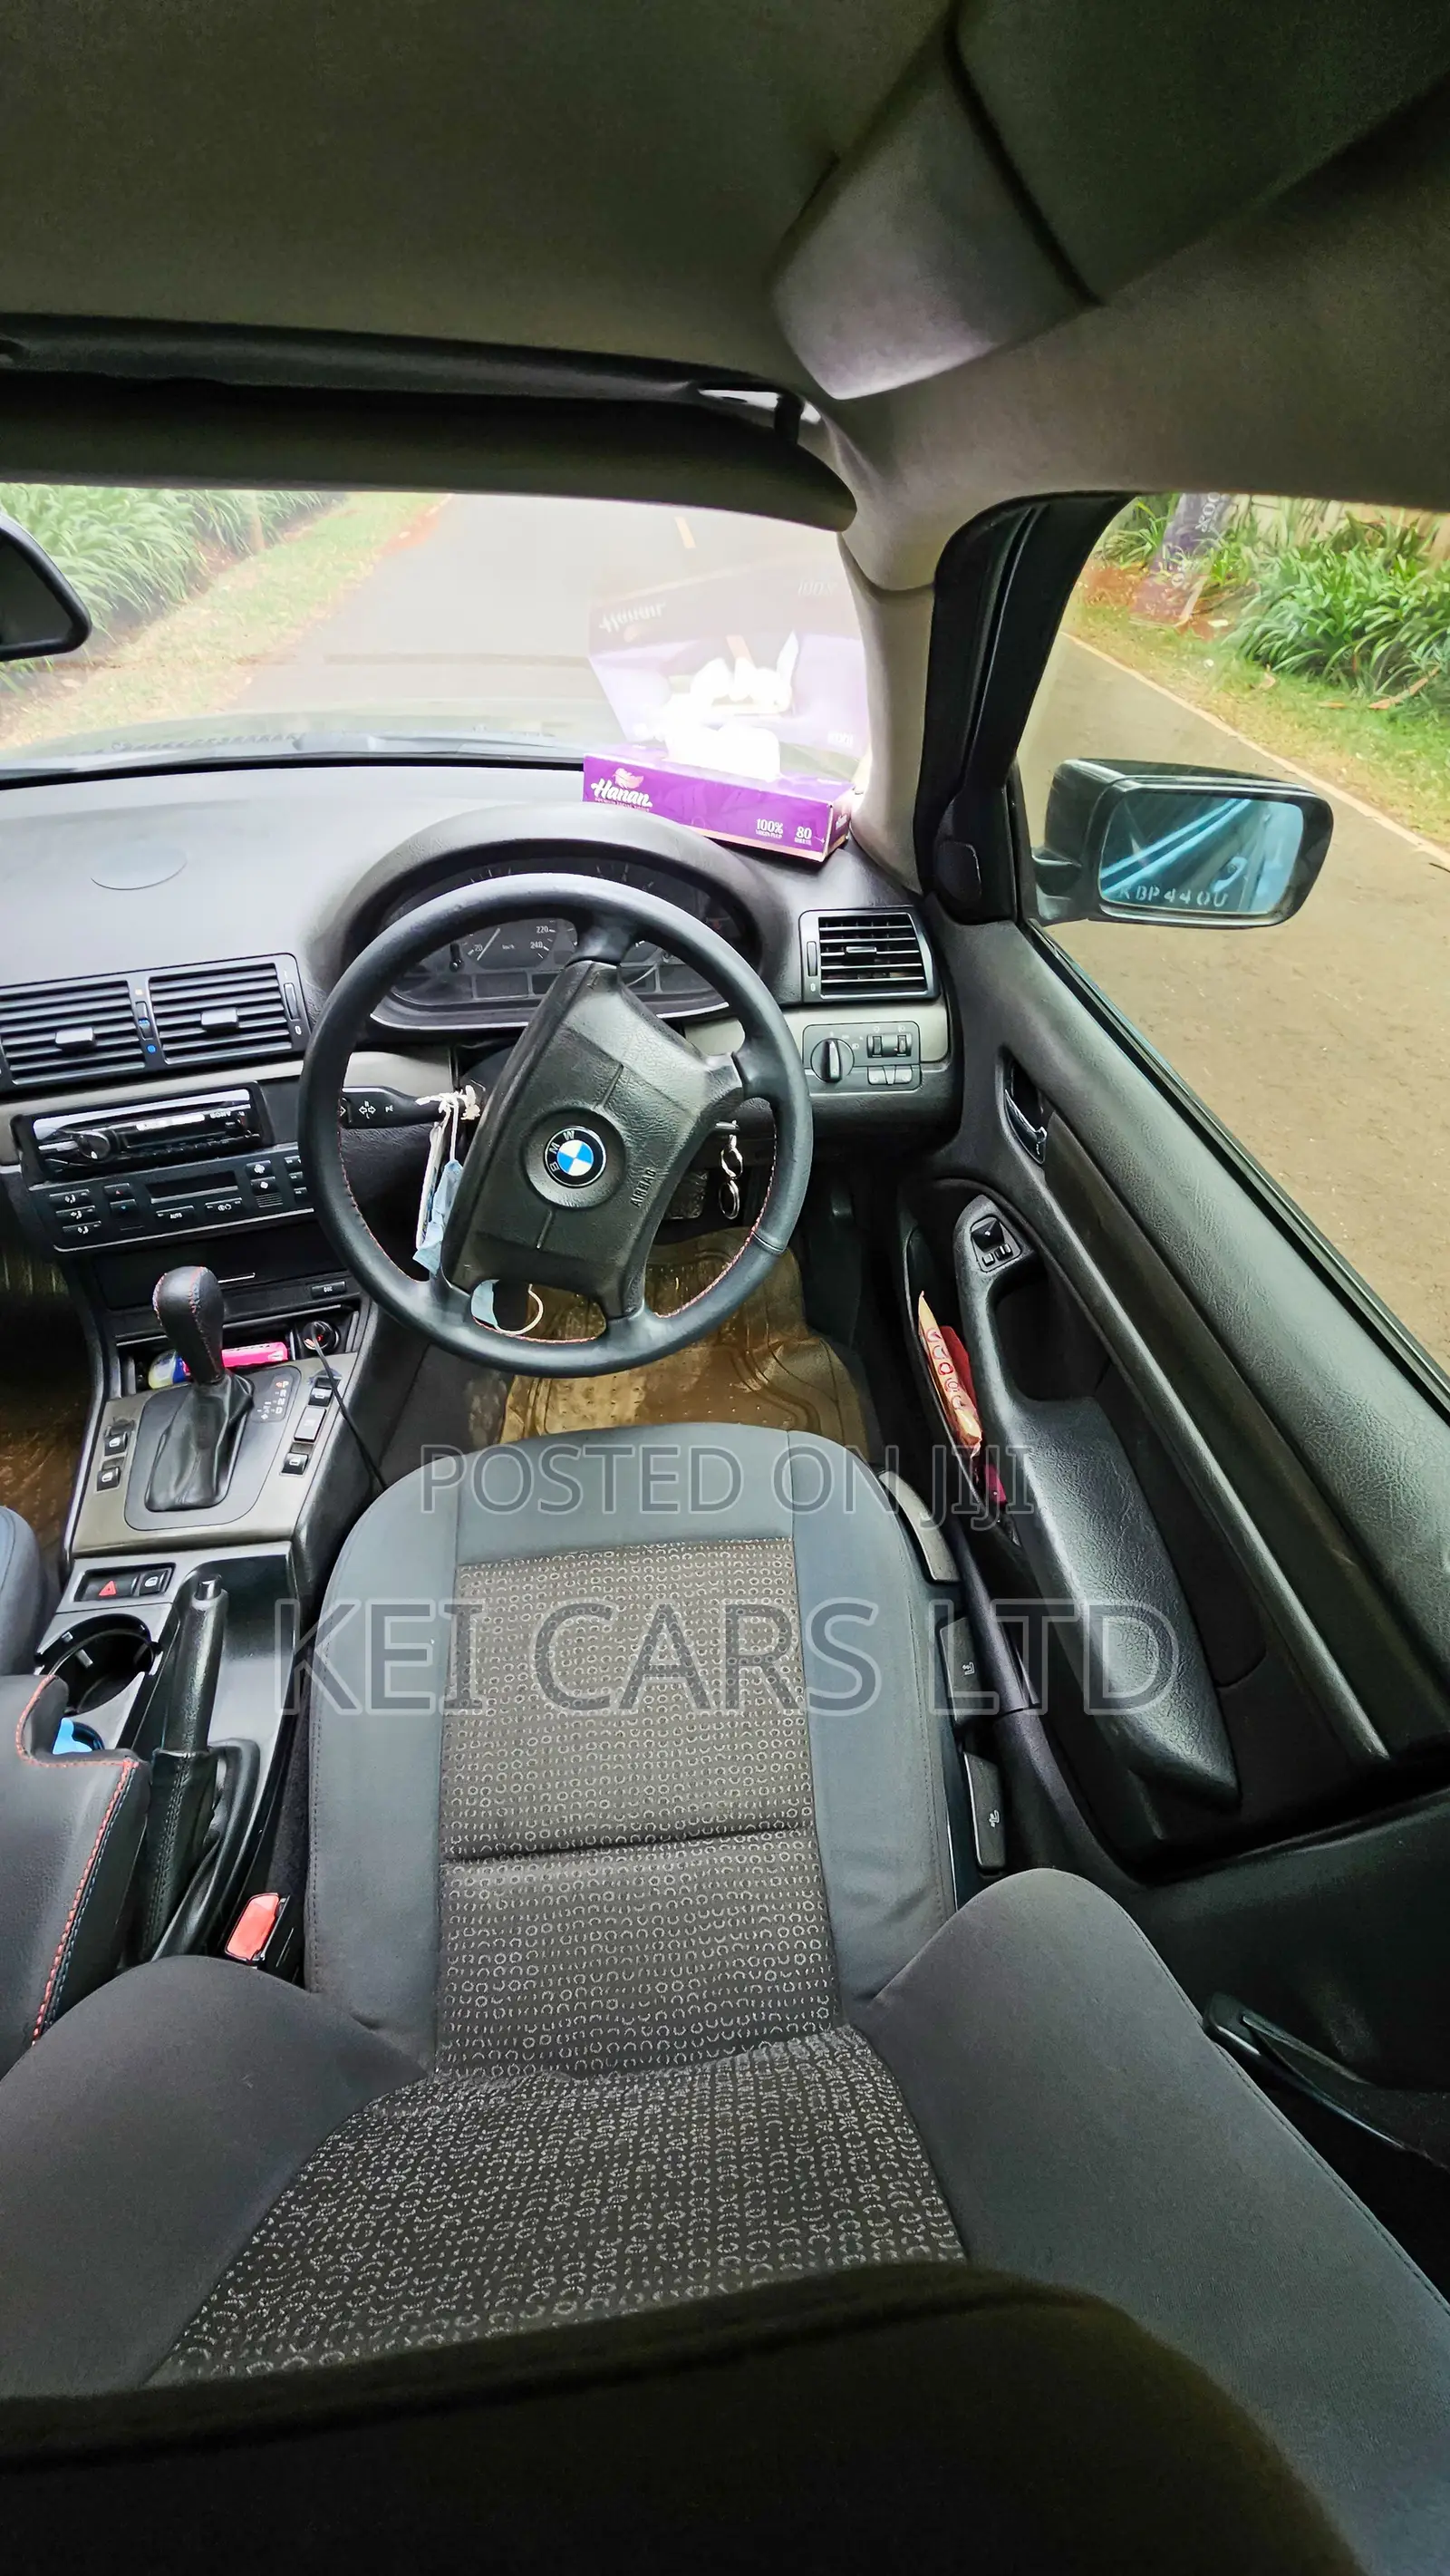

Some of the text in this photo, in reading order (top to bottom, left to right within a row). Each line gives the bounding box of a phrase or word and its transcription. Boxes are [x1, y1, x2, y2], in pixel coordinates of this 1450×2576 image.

[591, 778, 652, 808] Hanan
[757, 818, 783, 835] 100%
[797, 826, 812, 839] 80
[536, 925, 548, 934] 220
[530, 941, 543, 949] 240
[548, 1129, 575, 1172] BMW
[630, 1167, 657, 1208] AIRBAG
[282, 1380, 289, 1389] P
[277, 1397, 285, 1405] N
[275, 1406, 283, 1414] D
